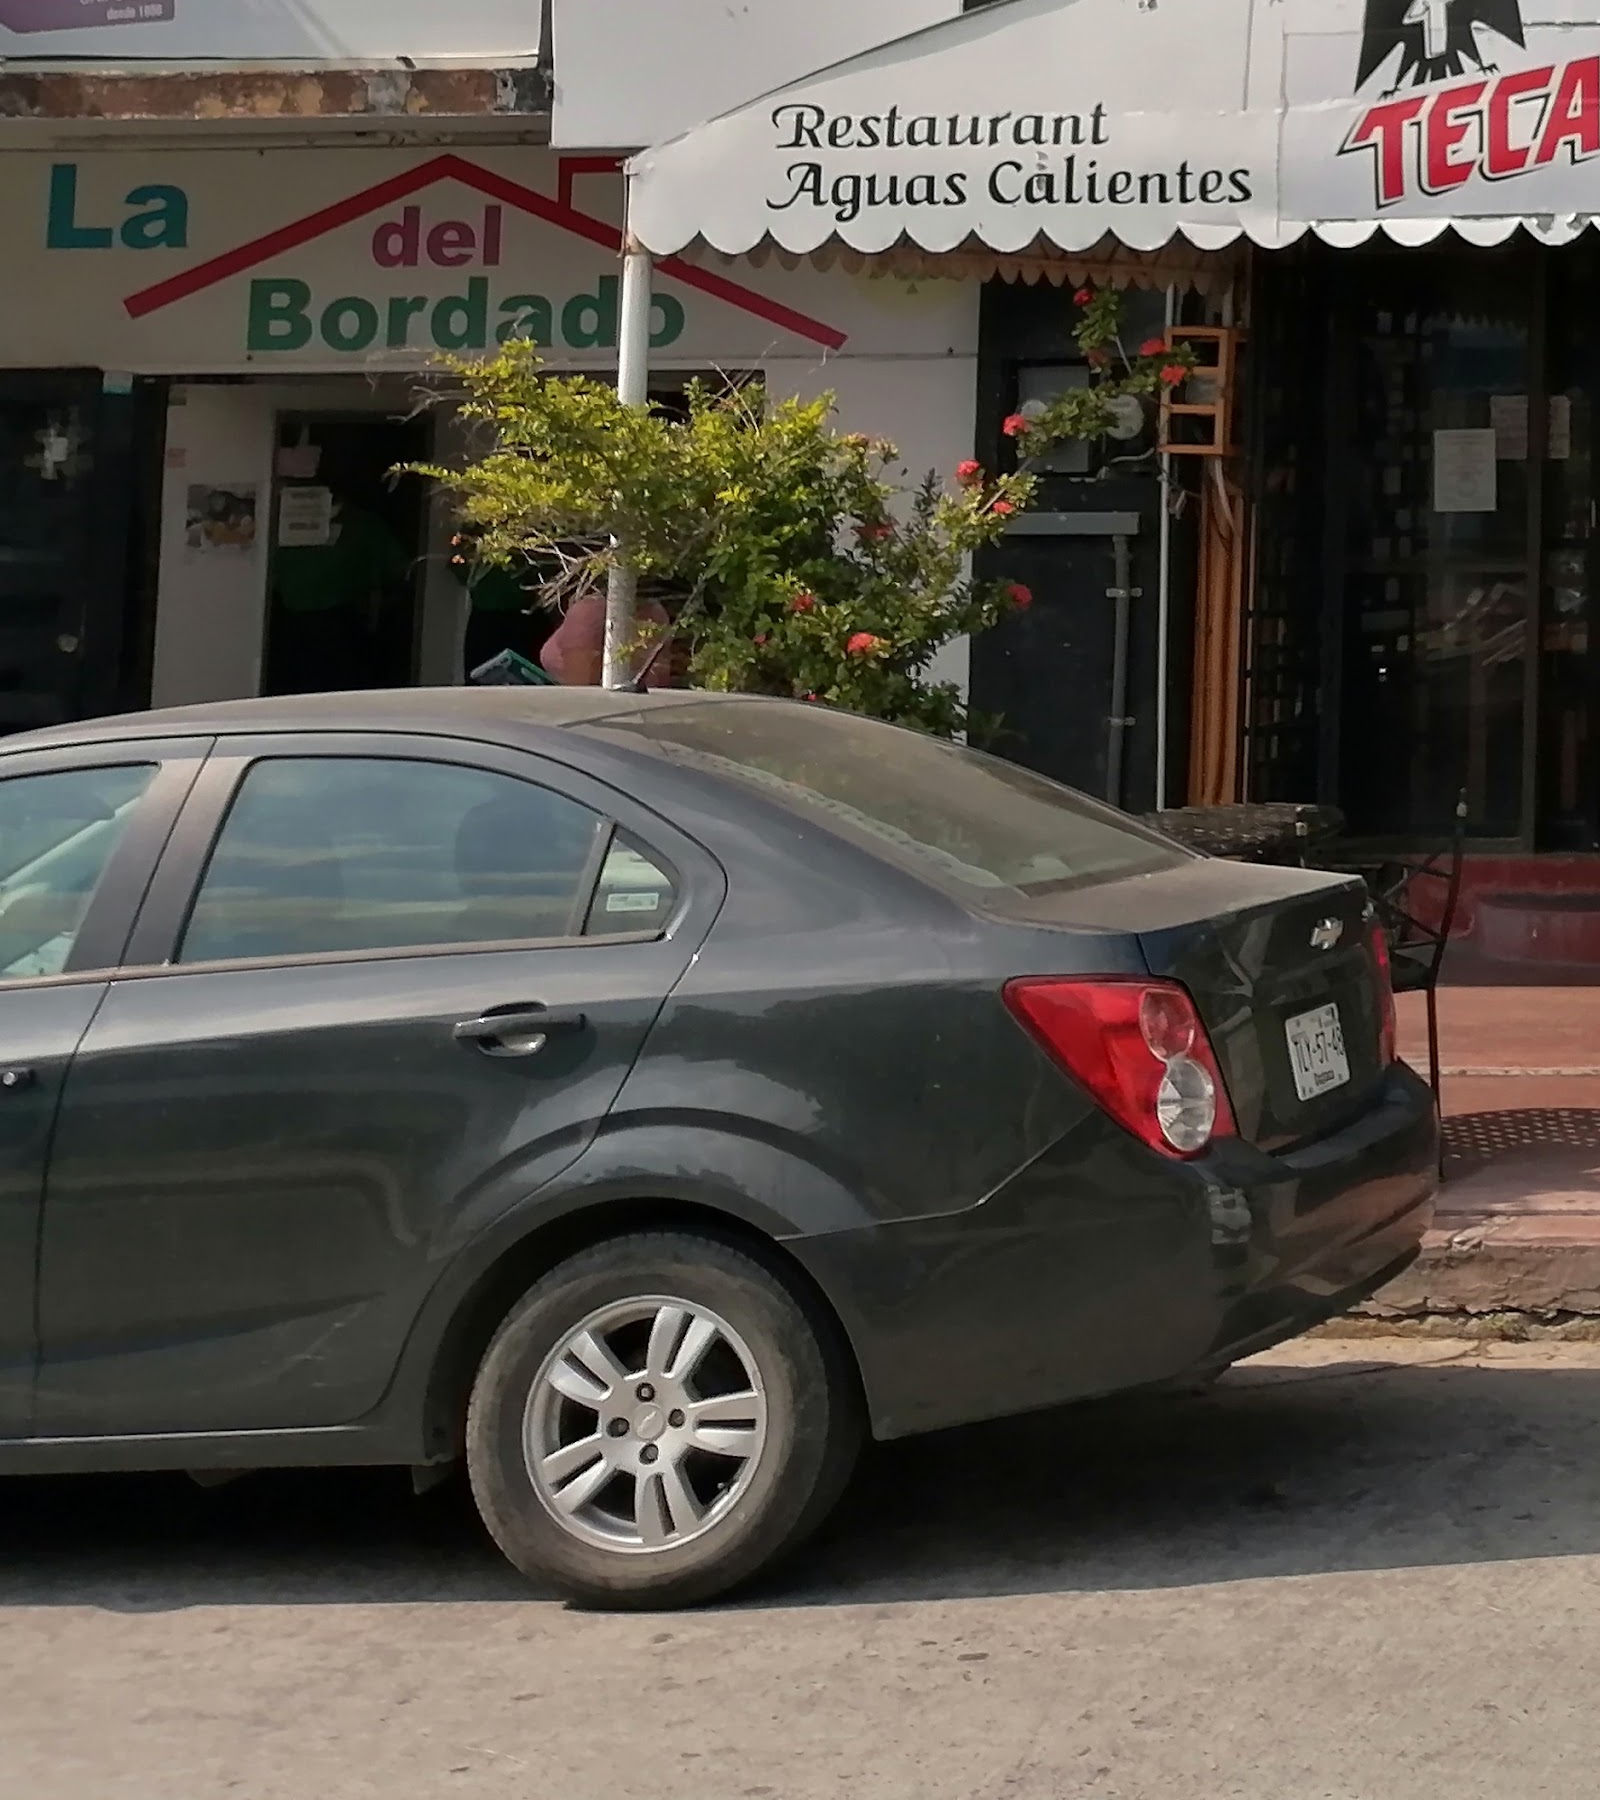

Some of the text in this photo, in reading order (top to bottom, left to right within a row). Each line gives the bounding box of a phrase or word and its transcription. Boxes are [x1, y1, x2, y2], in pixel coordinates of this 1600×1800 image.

[771, 101, 1110, 149] Restaurant
[47, 163, 189, 249] La
[765, 153, 1254, 222] Aguas Calientes
[371, 205, 503, 267] del
[246, 276, 686, 352] Bordado
